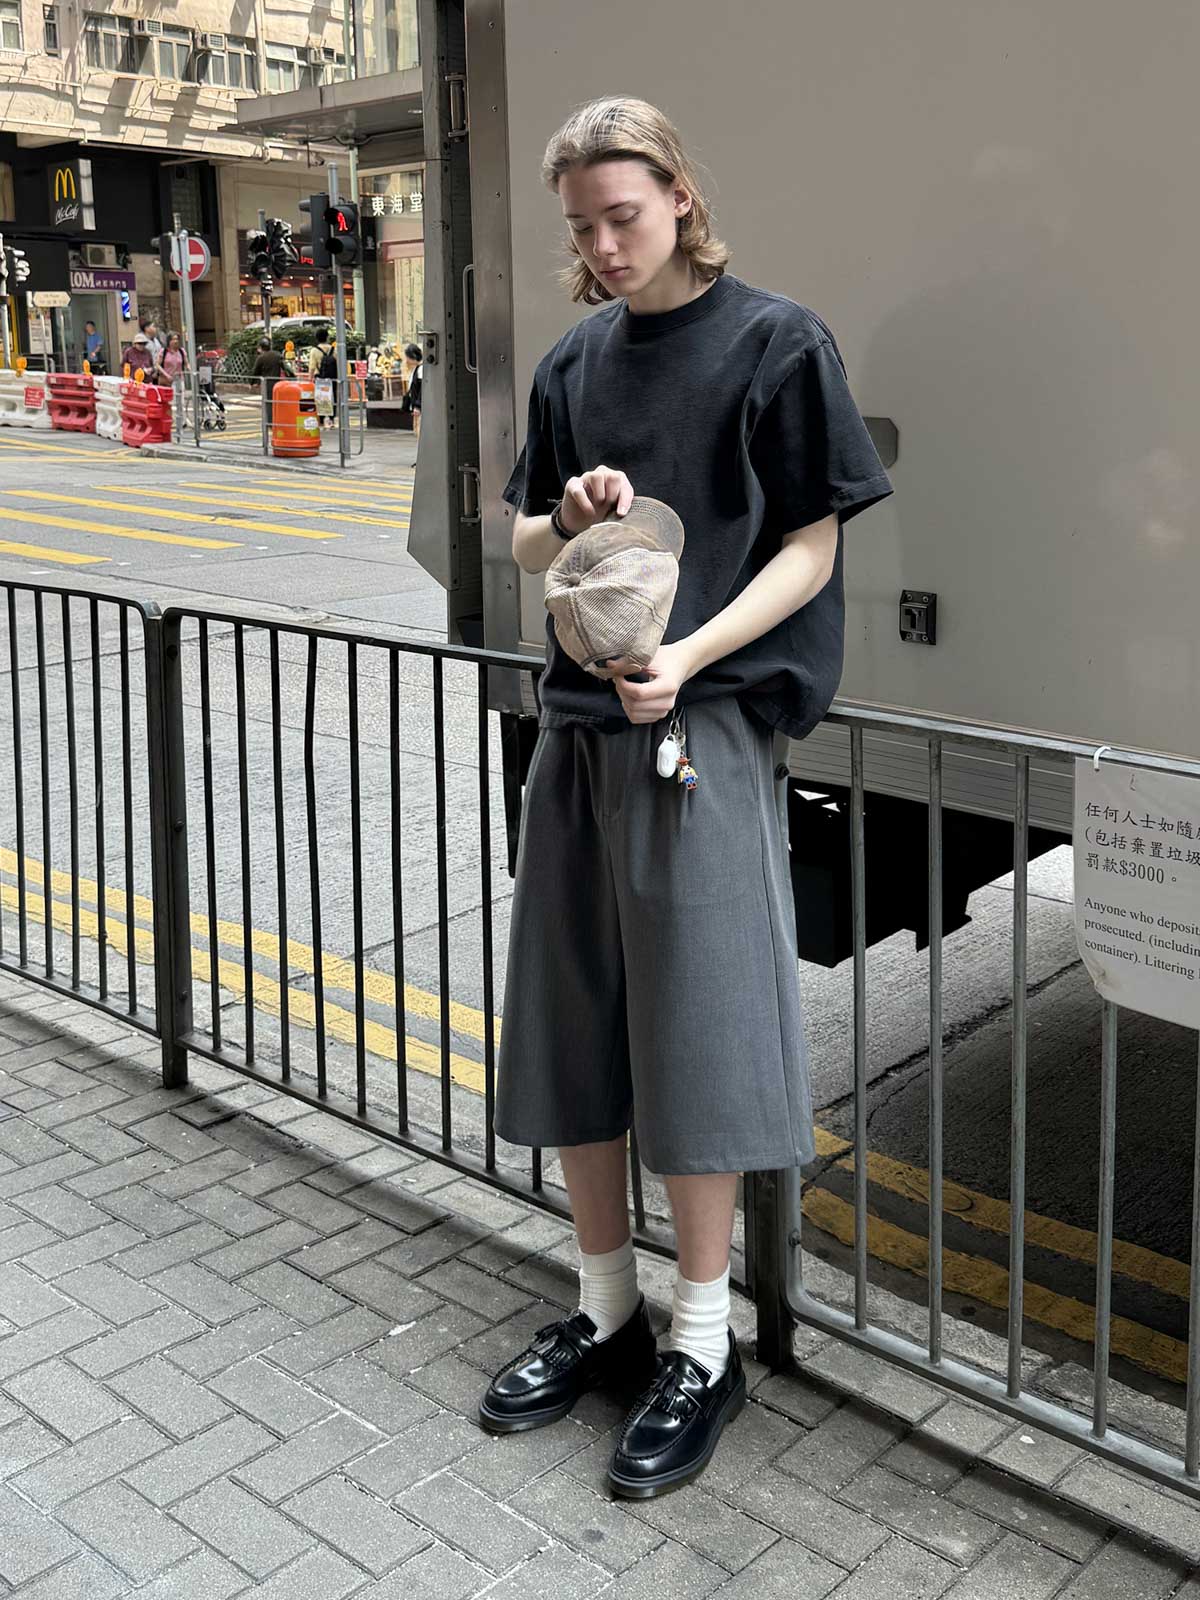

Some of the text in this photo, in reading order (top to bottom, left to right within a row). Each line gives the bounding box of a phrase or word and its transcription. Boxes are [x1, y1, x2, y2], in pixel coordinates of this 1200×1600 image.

[371, 191, 423, 216] 東海堂
[1084, 897, 1200, 936] Anyone who deposit
[1084, 919, 1145, 943] prosecuted.
[1084, 940, 1141, 965] container).
[1145, 954, 1195, 980] Littering
